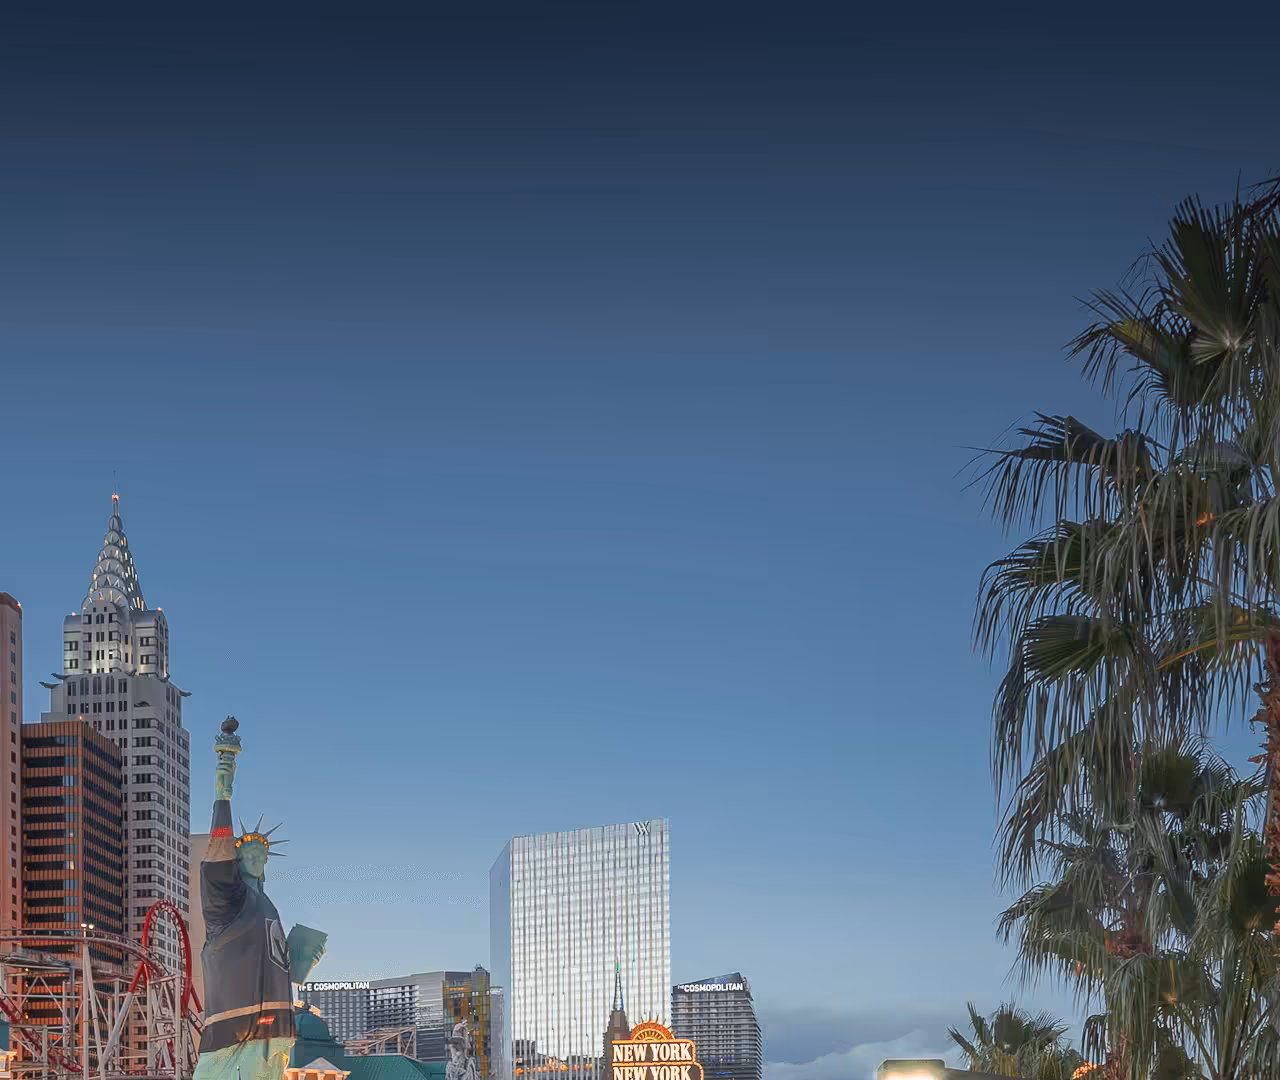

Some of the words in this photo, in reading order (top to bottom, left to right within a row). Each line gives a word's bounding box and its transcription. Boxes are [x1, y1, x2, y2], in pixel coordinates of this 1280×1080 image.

[313, 981, 370, 991] COSMOPOLITAN
[684, 982, 743, 993] COSMOPOLITAN
[613, 1044, 647, 1062] NEW
[650, 1043, 691, 1061] YORK
